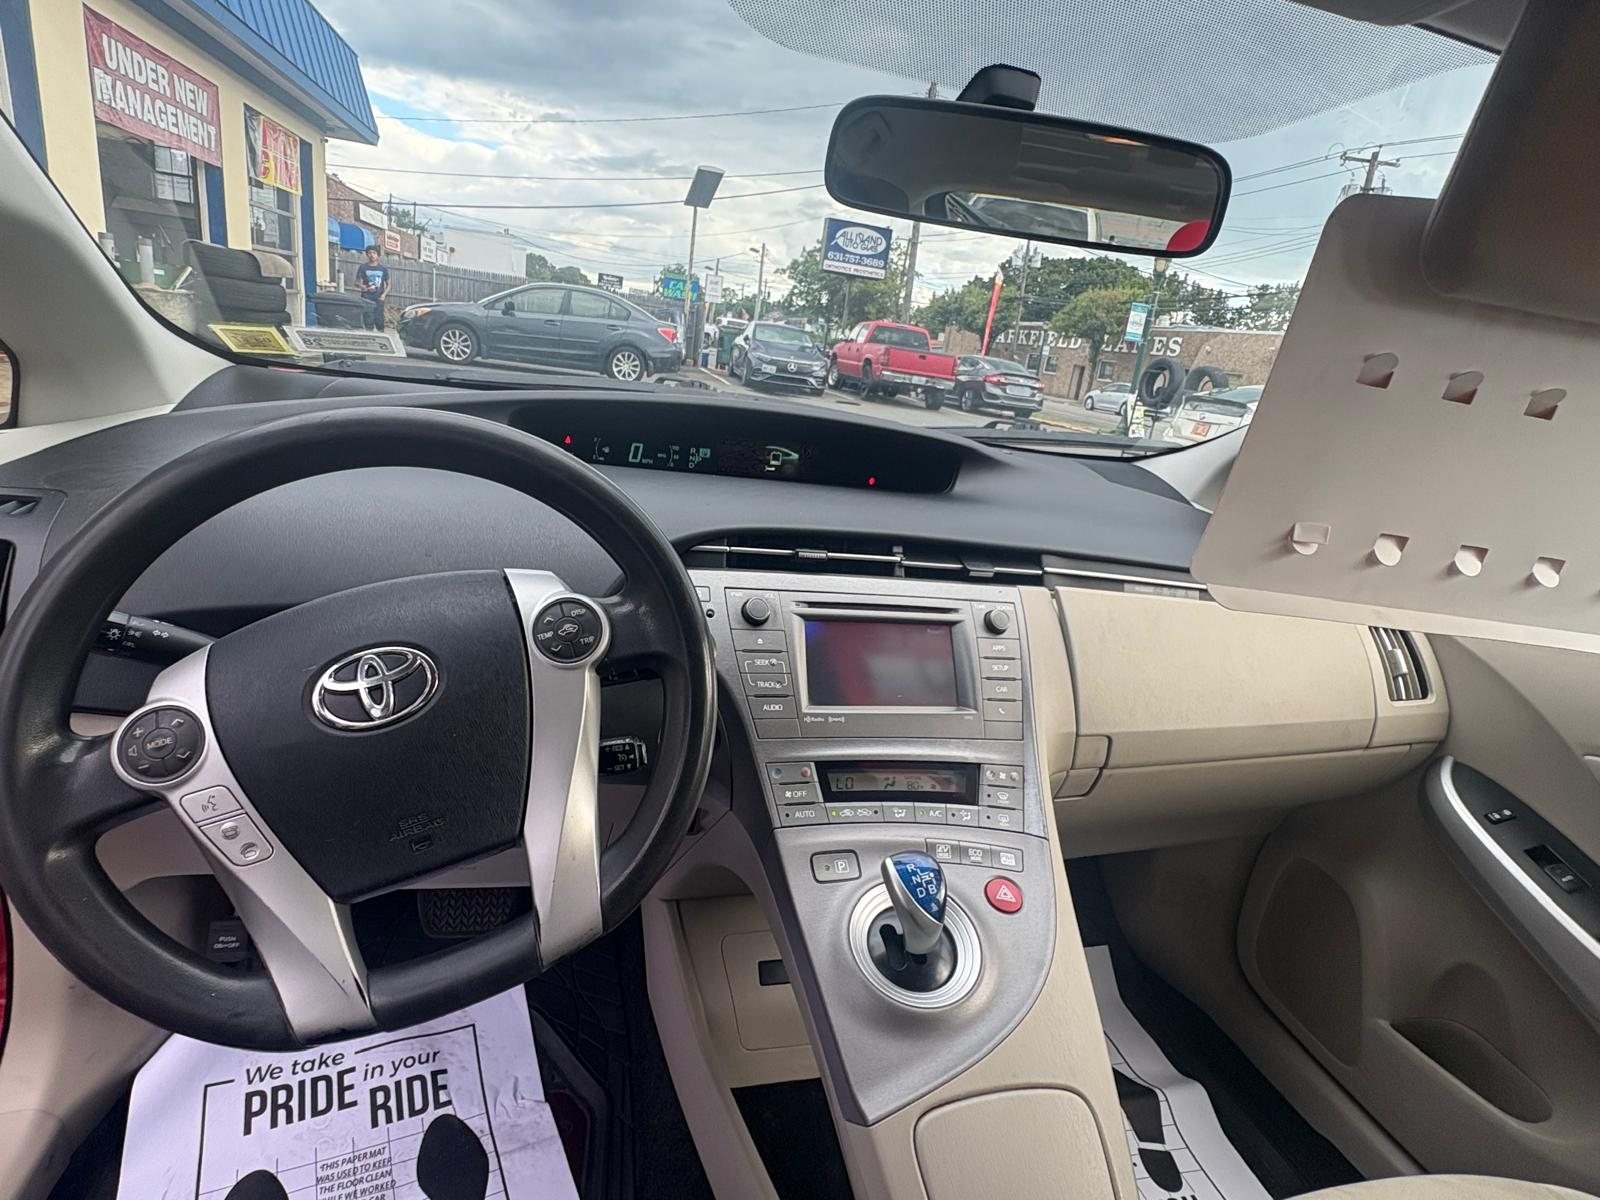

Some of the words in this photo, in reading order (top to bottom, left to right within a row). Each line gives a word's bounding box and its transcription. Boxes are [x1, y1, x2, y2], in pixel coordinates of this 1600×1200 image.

[102, 33, 172, 98] UNDER
[173, 73, 208, 117] NEW
[93, 67, 217, 152] MANAGEMENT
[1101, 335, 1183, 357] LAES
[536, 630, 554, 640] TEMP
[580, 636, 595, 644] TRIP
[995, 685, 1008, 693] CAR
[762, 703, 784, 712] AUDIO
[144, 736, 173, 750] MODE
[793, 790, 807, 798] OFF
[794, 810, 816, 818] AUTO
[929, 809, 943, 817] A/C
[968, 848, 983, 857] ECO
[906, 864, 917, 872] R
[912, 875, 921, 884] N
[916, 887, 926, 898] D
[928, 884, 937, 894] B
[246, 1063, 283, 1085] We
[291, 1053, 345, 1075] take
[243, 1066, 358, 1137] PRIDE
[363, 1064, 384, 1082] in
[389, 1050, 440, 1078] your
[369, 1068, 453, 1130] RIDE
[320, 1159, 340, 1172] THIS
[341, 1152, 368, 1166] PAPER
[369, 1146, 387, 1159] MAT
[316, 1172, 336, 1185] WAS
[336, 1166, 359, 1180] USED
[360, 1163, 371, 1174] TO
[372, 1156, 393, 1170] KEEP
[319, 1184, 336, 1195] THE
[337, 1176, 364, 1191] FLOOR
[365, 1168, 393, 1183] CLEAN
[344, 1189, 358, 1199] WE
[359, 1179, 396, 1196] WORKED
